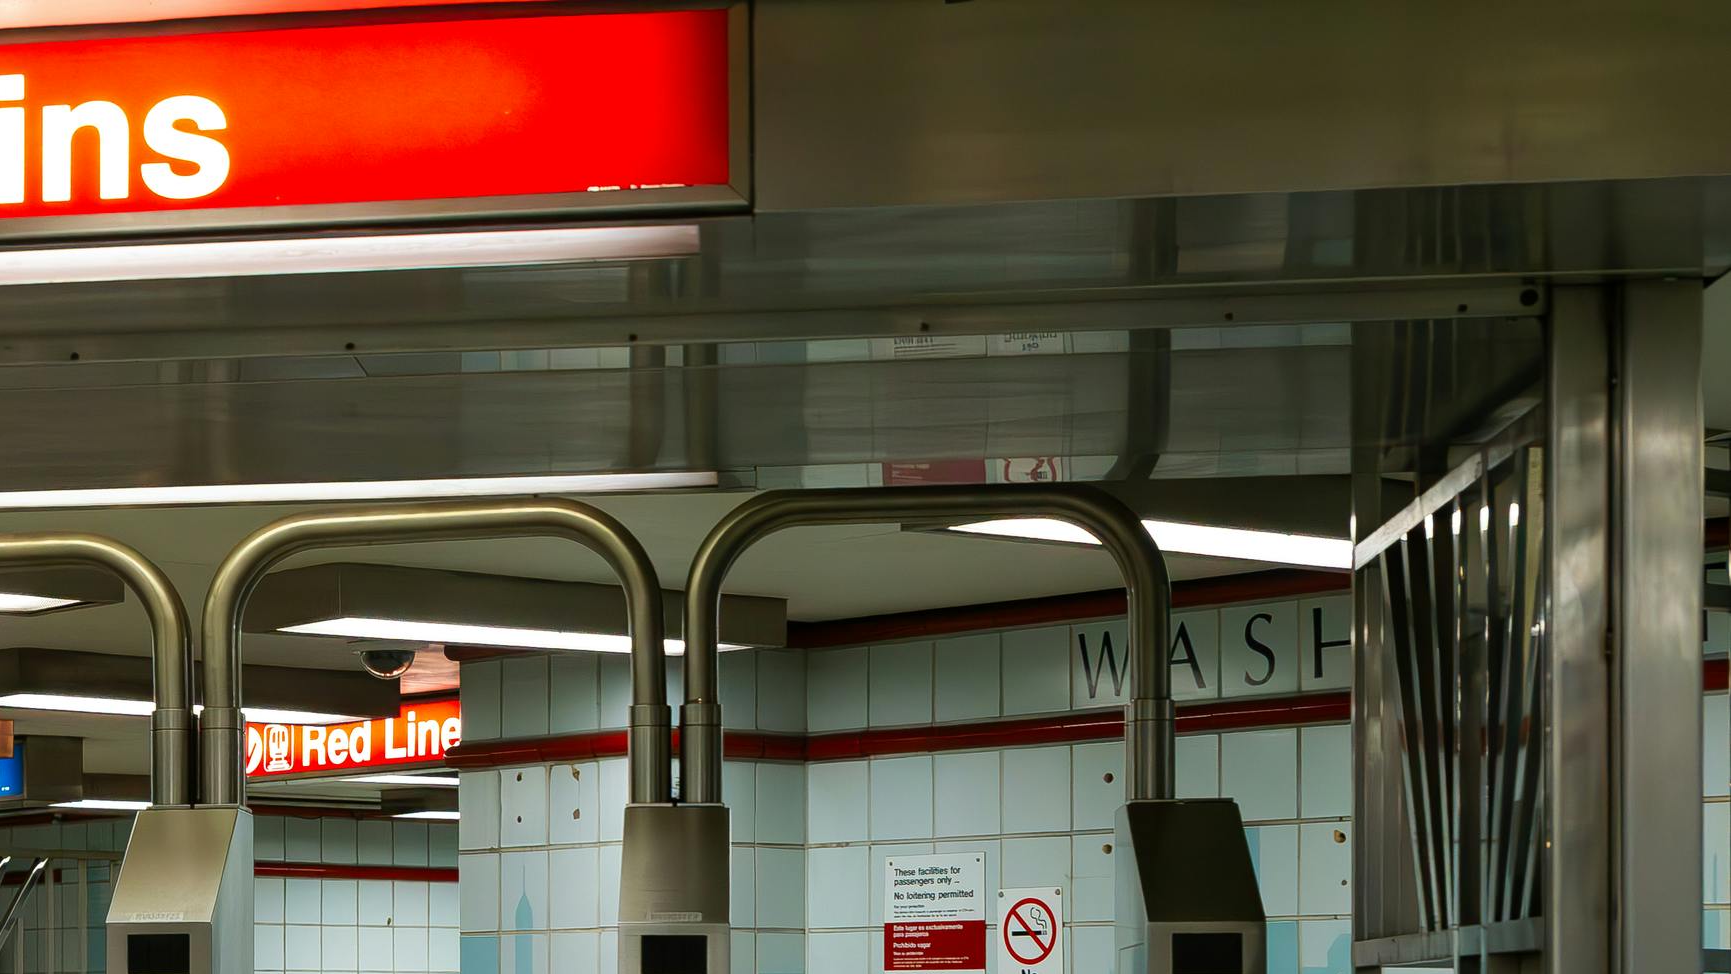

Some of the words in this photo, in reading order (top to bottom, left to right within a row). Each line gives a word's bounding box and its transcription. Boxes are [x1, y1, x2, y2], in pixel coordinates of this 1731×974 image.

[301, 720, 371, 767] Red
[384, 710, 462, 760] Line
[894, 868, 916, 876] These
[918, 866, 948, 876] facilities
[950, 866, 961, 875] for
[894, 878, 935, 887] passengers
[936, 877, 953, 886] only
[894, 892, 904, 900] No
[906, 891, 936, 902] loitering
[938, 889, 974, 900] permitted
